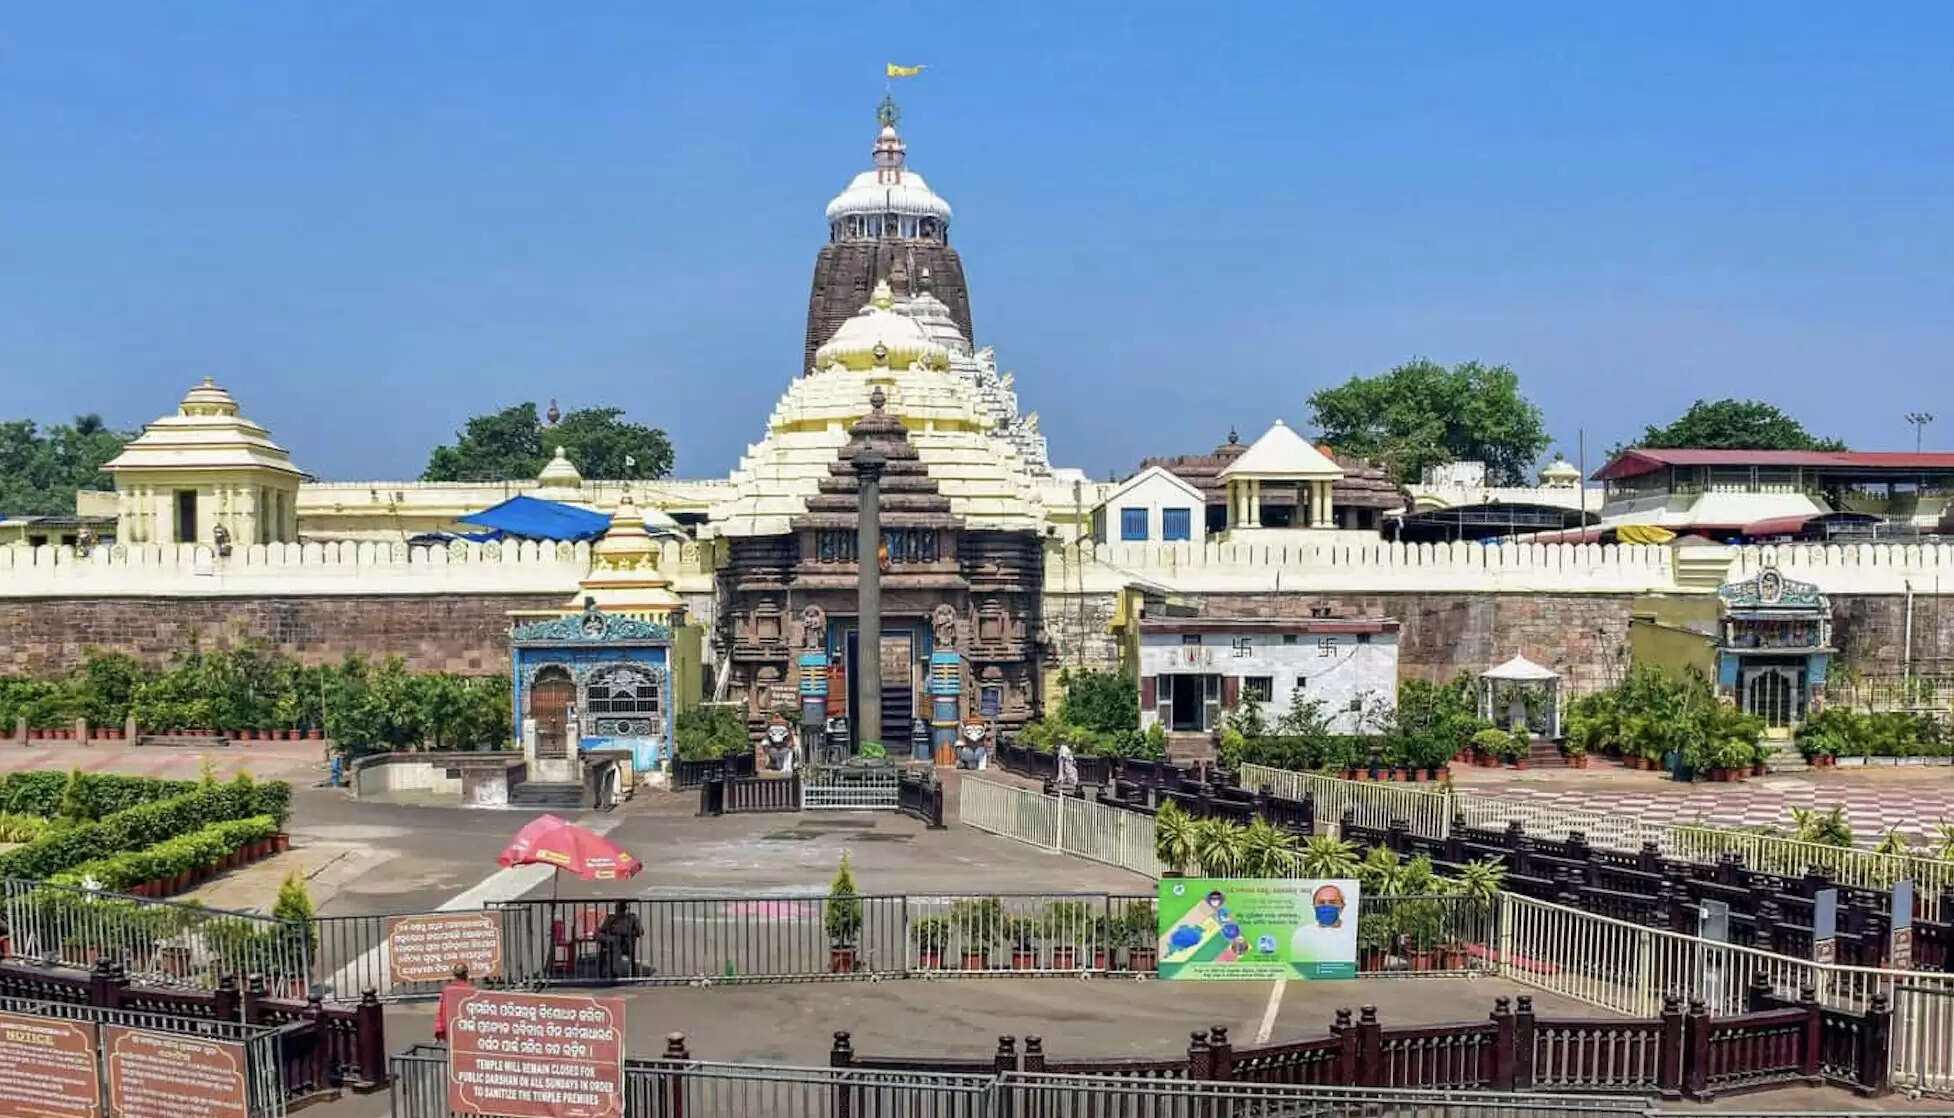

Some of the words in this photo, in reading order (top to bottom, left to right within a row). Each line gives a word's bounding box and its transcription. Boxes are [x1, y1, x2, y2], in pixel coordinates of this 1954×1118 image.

[6, 1029, 55, 1045] NOTICE
[476, 1059, 503, 1071] TEMPLE
[504, 1060, 520, 1073] WILL
[522, 1062, 550, 1074] REMAIN
[551, 1064, 579, 1076] CLOSED
[581, 1066, 596, 1078] FOR
[458, 1072, 484, 1083] PUBLIC
[485, 1073, 519, 1085] DARSHAN
[519, 1075, 529, 1087] ON
[530, 1076, 544, 1088] ALL
[546, 1077, 578, 1090] SUNDAYS
[580, 1080, 589, 1091] IN
[589, 1081, 614, 1093] ORDER
[474, 1085, 484, 1097] TO
[485, 1086, 517, 1100] SANITIZE
[518, 1089, 532, 1101] THE
[533, 1091, 562, 1103] TEMPLE
[563, 1092, 599, 1105] PREMISES
